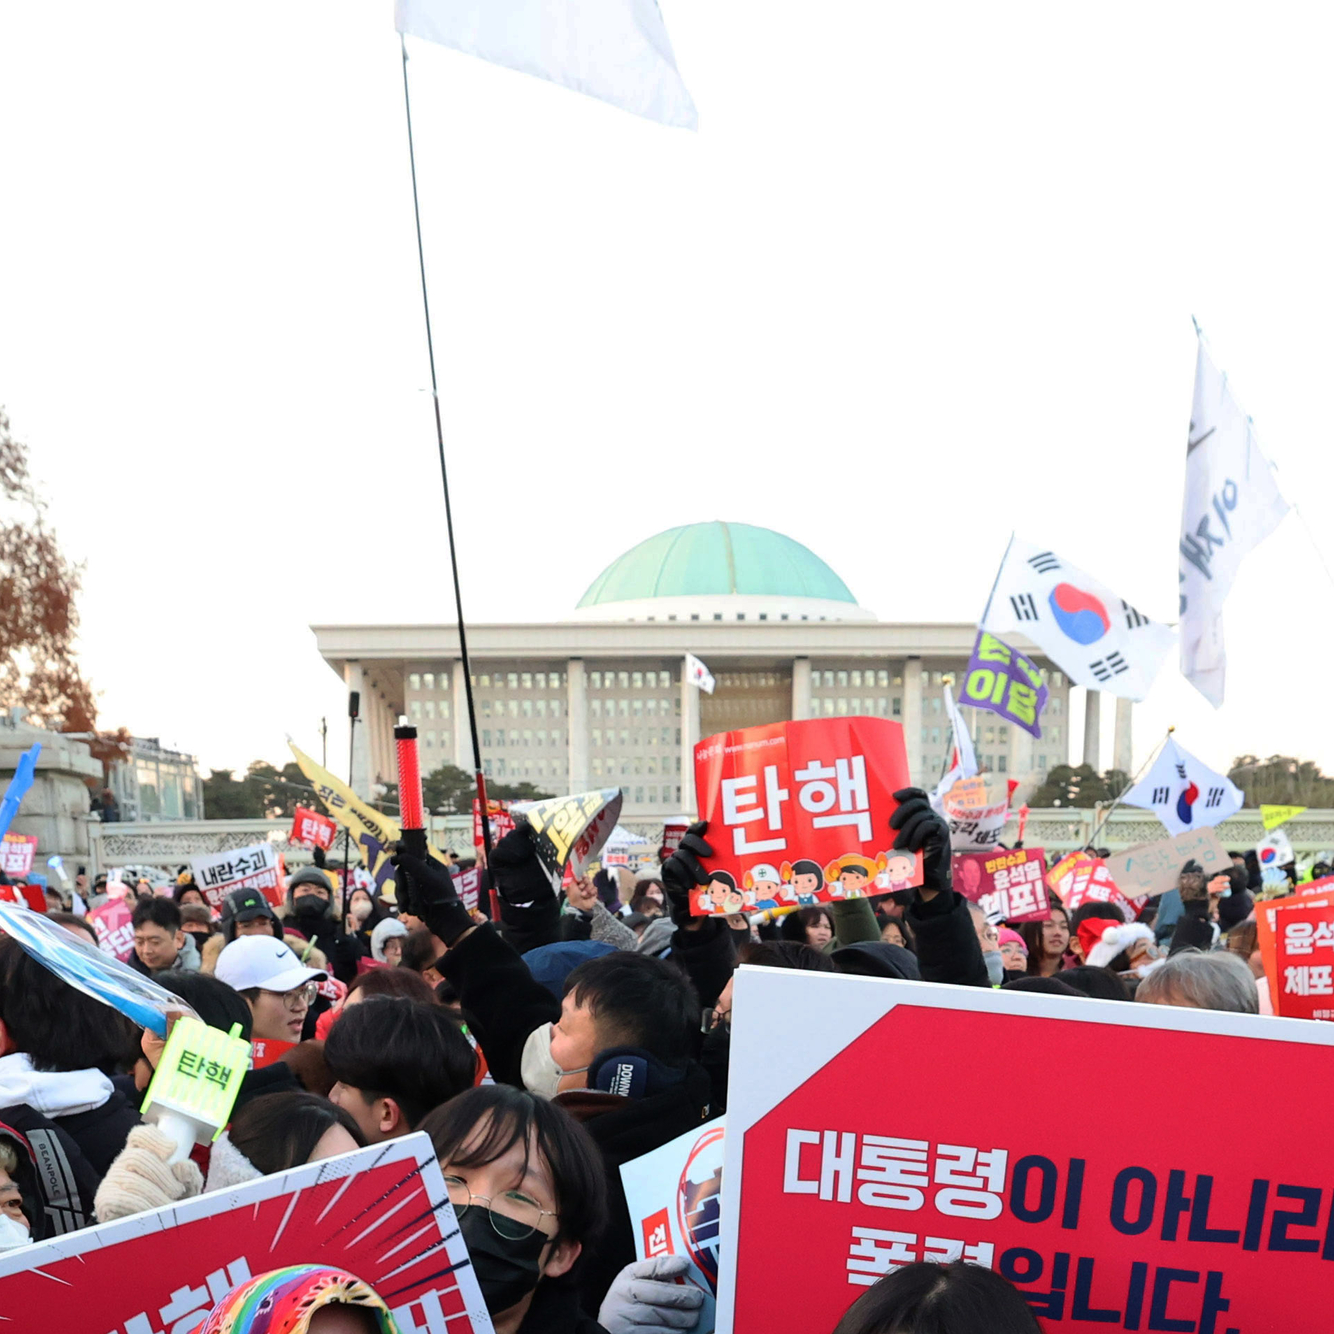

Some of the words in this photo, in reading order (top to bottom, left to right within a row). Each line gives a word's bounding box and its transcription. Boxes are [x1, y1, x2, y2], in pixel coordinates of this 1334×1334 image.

[723, 736, 785, 755] www.nanum.com
[721, 754, 872, 855] 탄핵
[202, 850, 266, 886] 내란수괴
[993, 859, 1042, 891] 윤석열
[176, 1048, 234, 1092] 탄핵
[37, 1142, 61, 1198] BEANPOLE
[783, 1128, 1083, 1231] 대통령이
